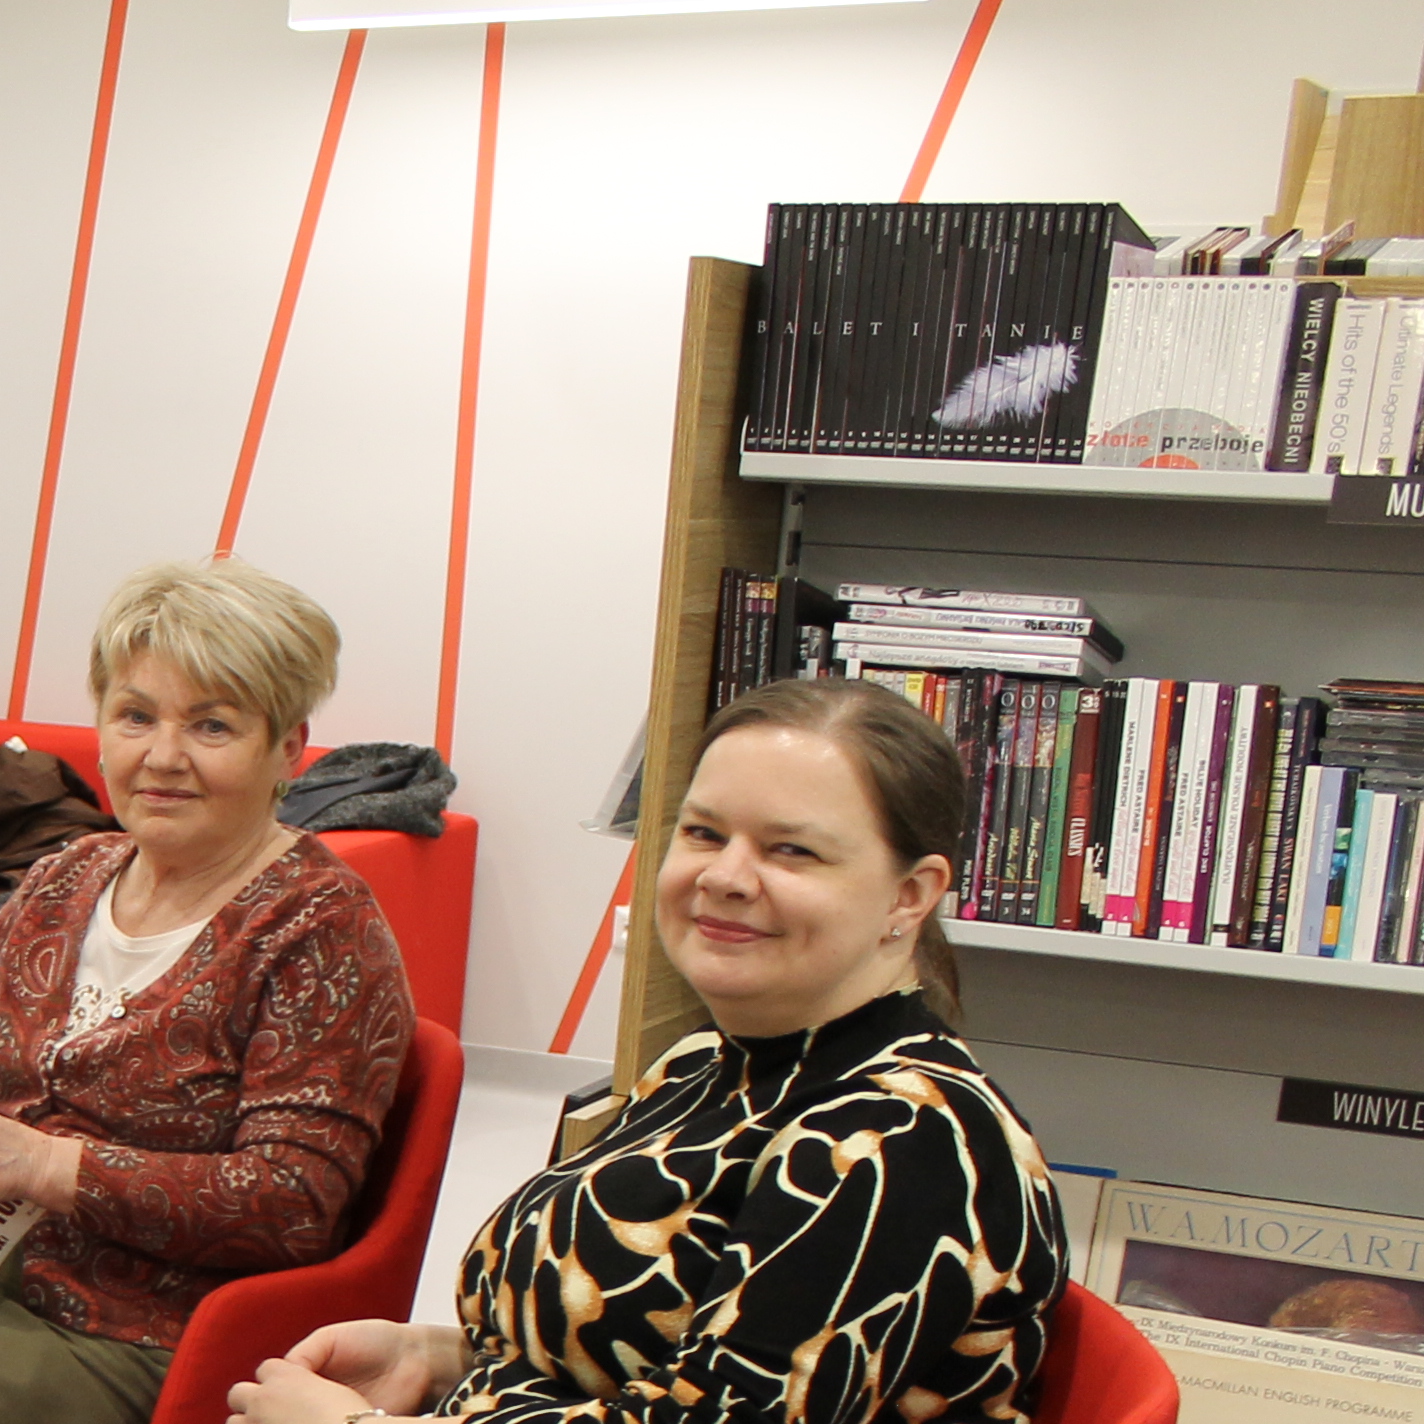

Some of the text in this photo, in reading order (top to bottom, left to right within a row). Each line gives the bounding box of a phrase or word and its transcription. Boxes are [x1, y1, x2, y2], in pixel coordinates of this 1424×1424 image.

[1284, 298, 1325, 463] WIELCY NIEOBECNI
[1327, 314, 1365, 453] Hits of the 50's
[1378, 315, 1414, 454] Ultimate Legends
[1087, 429, 1265, 453] złote przeboje
[1124, 721, 1136, 765] MARLENE
[1119, 766, 1132, 808] DIETRICH
[1135, 769, 1146, 794] FRED
[1191, 759, 1207, 829] BILLIE HOLIDAY
[1131, 795, 1143, 834] ASTAIRE
[1174, 772, 1189, 837] FRED ASTAIRE
[1067, 817, 1086, 856] CLASSICS
[1280, 837, 1294, 869] SWAN
[1275, 873, 1290, 904] LAKE
[1332, 1091, 1424, 1132] WINYLE
[1210, 1215, 1424, 1272] MOZART
[1184, 1336, 1266, 1359] International
[1264, 1350, 1307, 1368] Chopin
[1312, 1359, 1345, 1374] Piano
[1349, 1364, 1423, 1388] Competition
[1251, 1335, 1297, 1353] Konkurs
[1335, 1349, 1380, 1368] Chopina
[1263, 1387, 1320, 1408] ENGLISH
[1325, 1398, 1413, 1422] PROGRAMME
